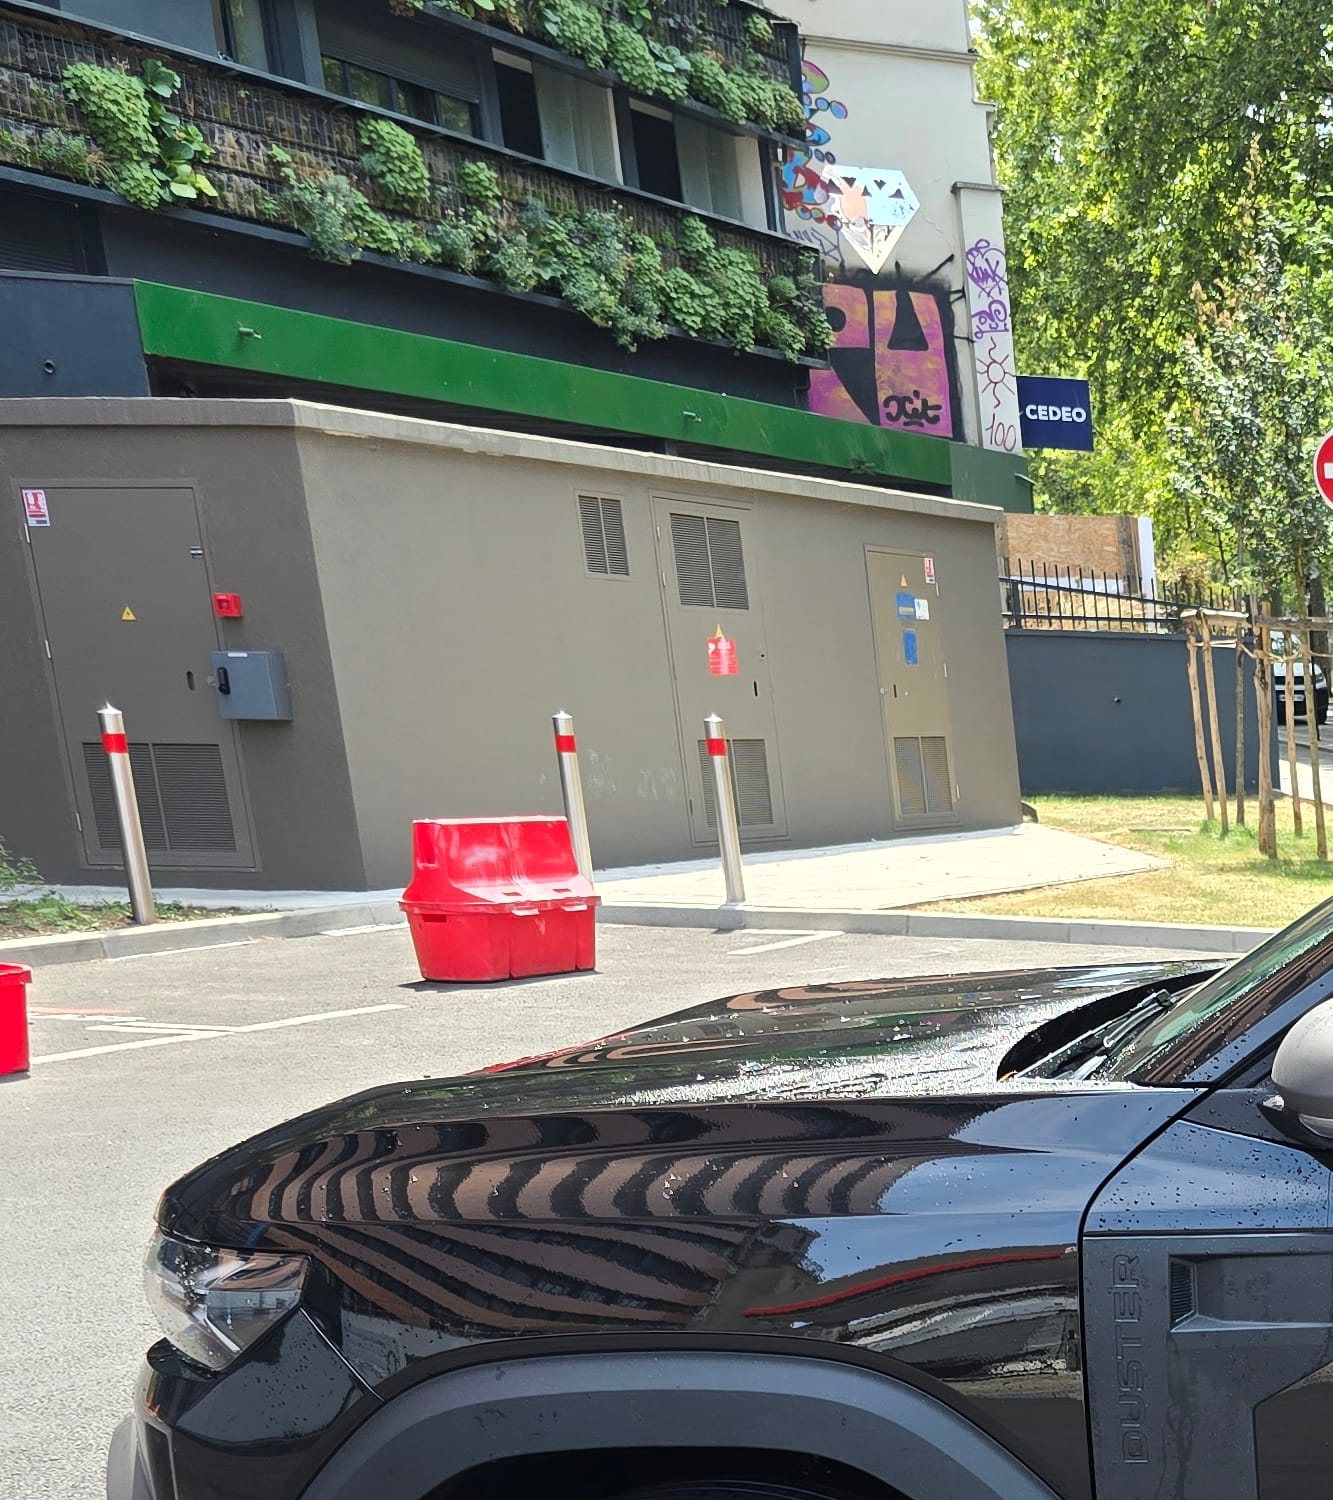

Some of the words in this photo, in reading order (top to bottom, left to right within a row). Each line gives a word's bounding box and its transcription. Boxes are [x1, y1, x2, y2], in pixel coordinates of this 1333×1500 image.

[985, 413, 1017, 452] 100
[1025, 405, 1087, 423] CEDEO
[1112, 1253, 1150, 1465] DUSTER
